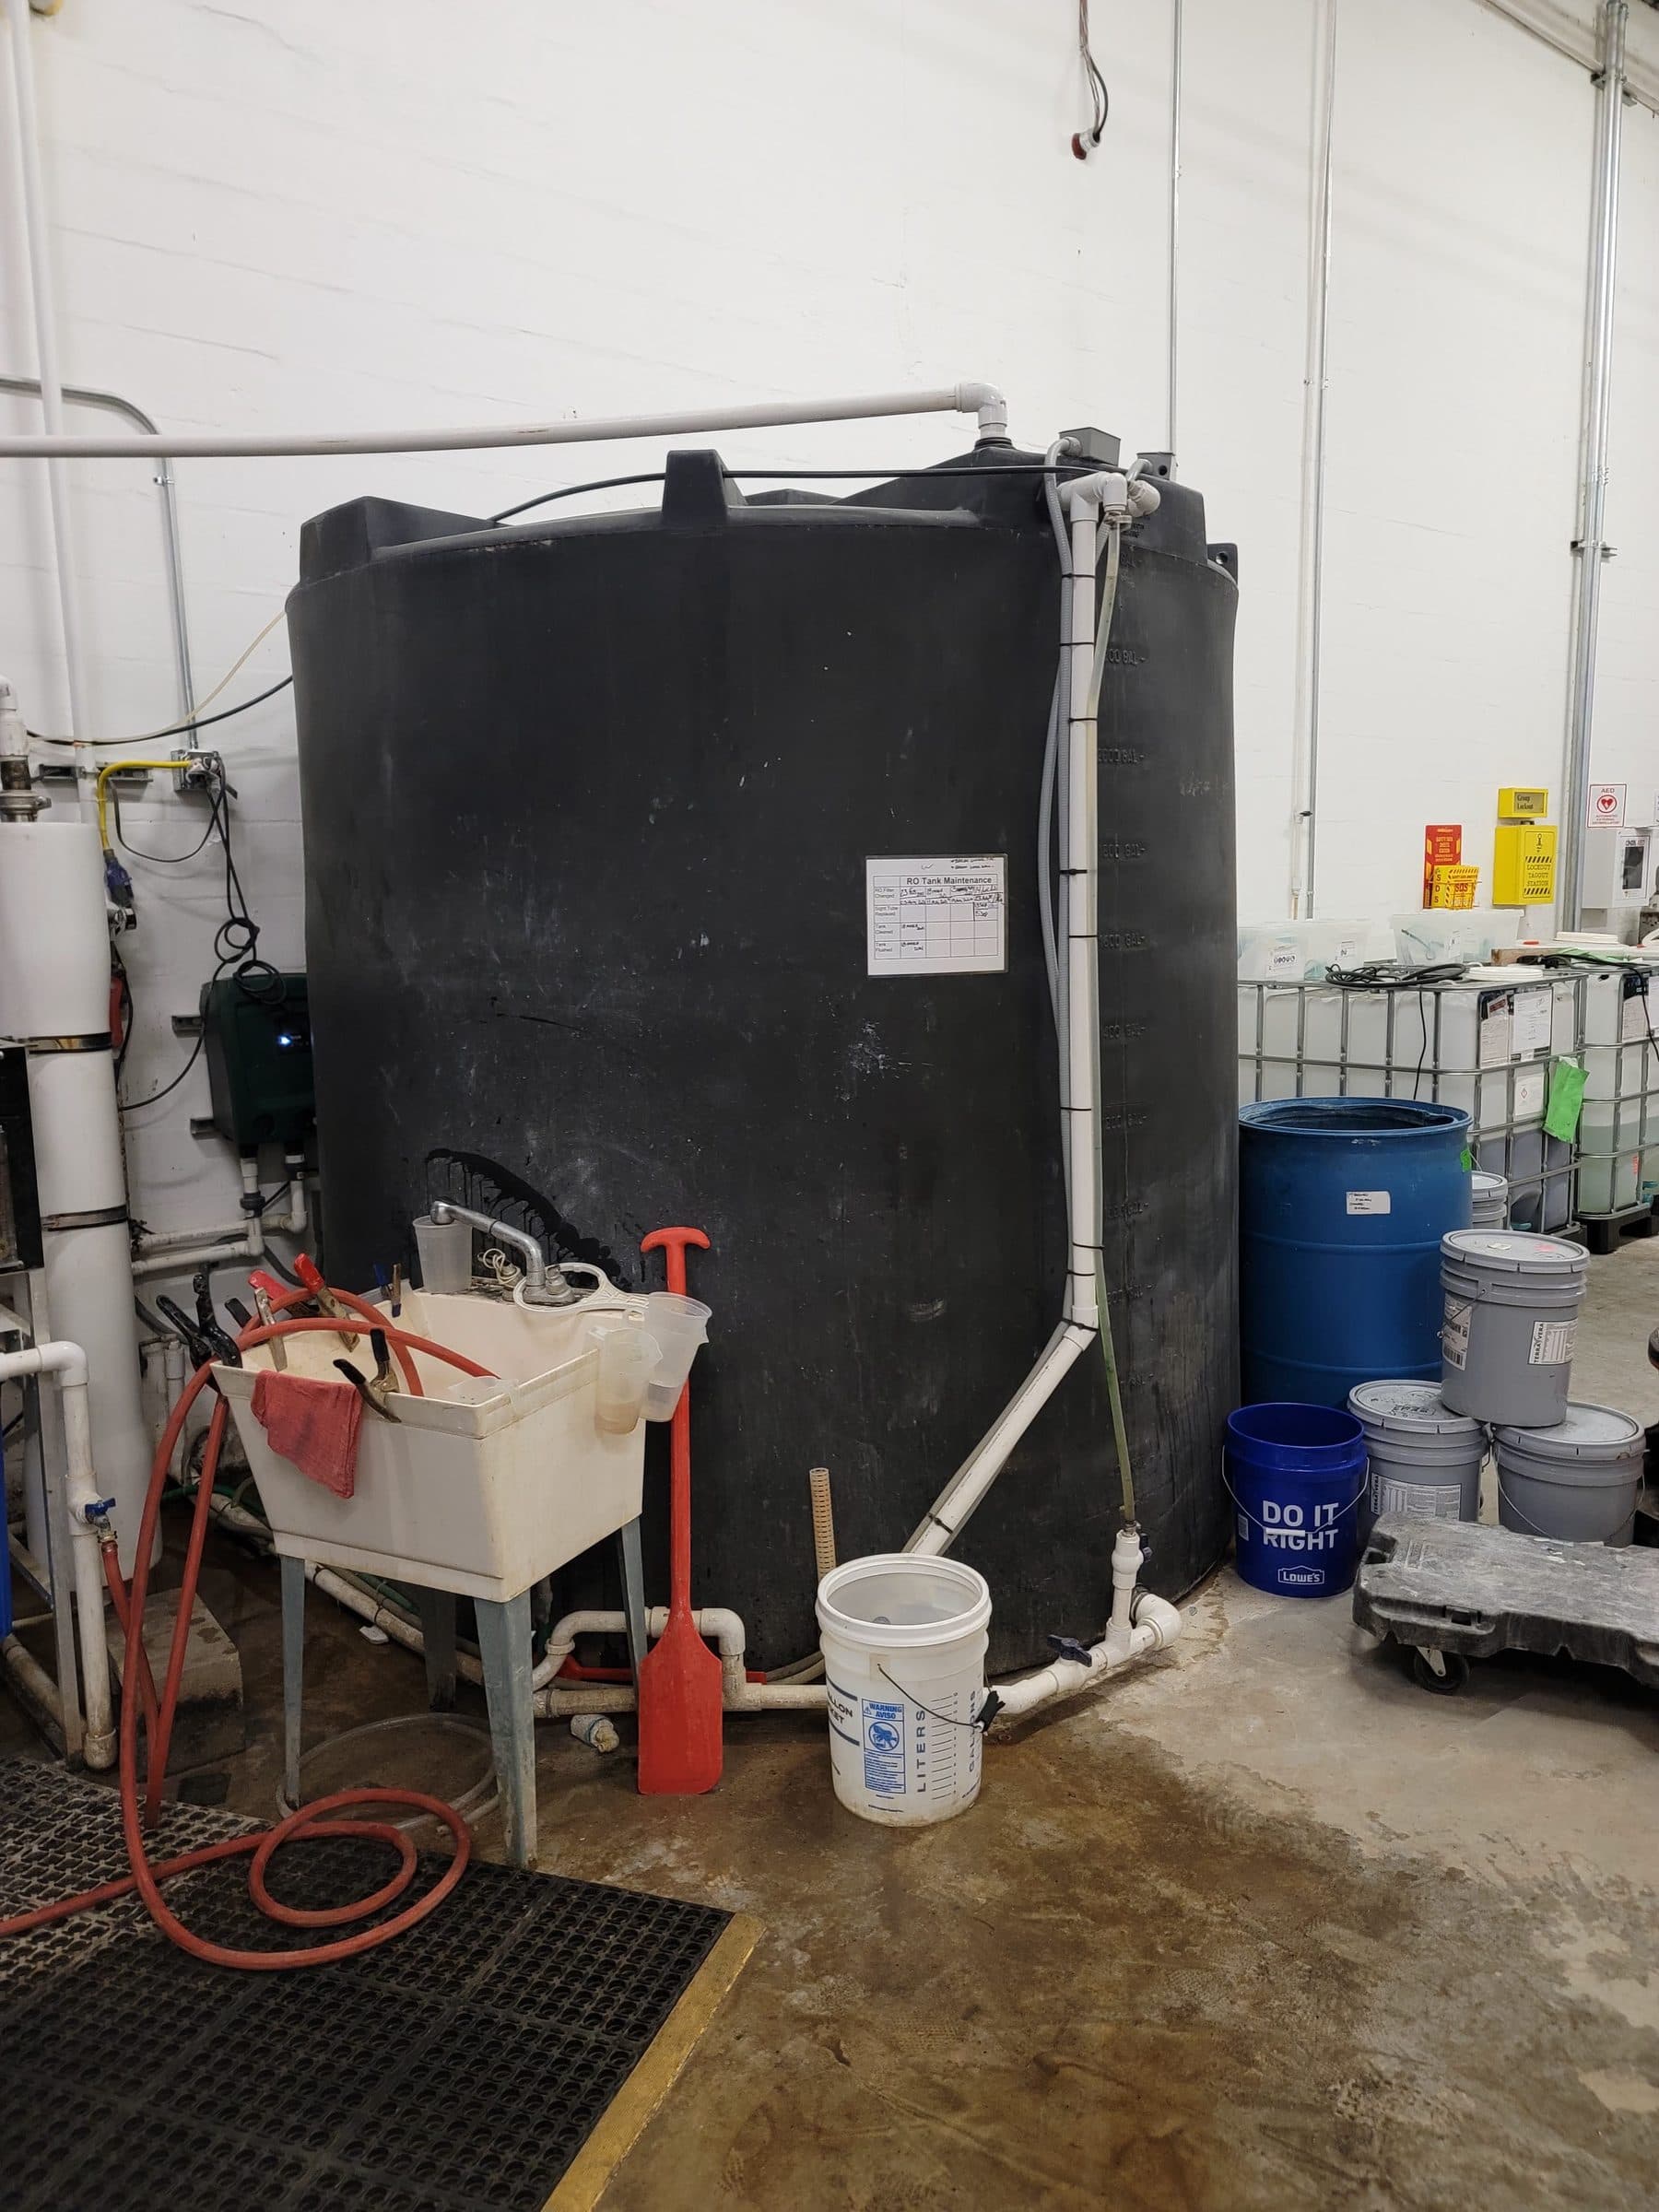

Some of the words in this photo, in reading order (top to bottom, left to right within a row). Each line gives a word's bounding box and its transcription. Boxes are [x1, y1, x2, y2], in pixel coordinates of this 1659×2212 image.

[923, 877, 942, 885] Tank
[943, 877, 992, 885] Maintenance
[1263, 1500, 1303, 1527] DO
[1314, 1503, 1339, 1527] IT
[1263, 1529, 1339, 1551] RIGHT
[1283, 1571, 1321, 1583] LOWE'S
[869, 1702, 902, 1713] WARNING
[875, 1712, 897, 1720] AVISO
[916, 1710, 926, 1793] LITERS
